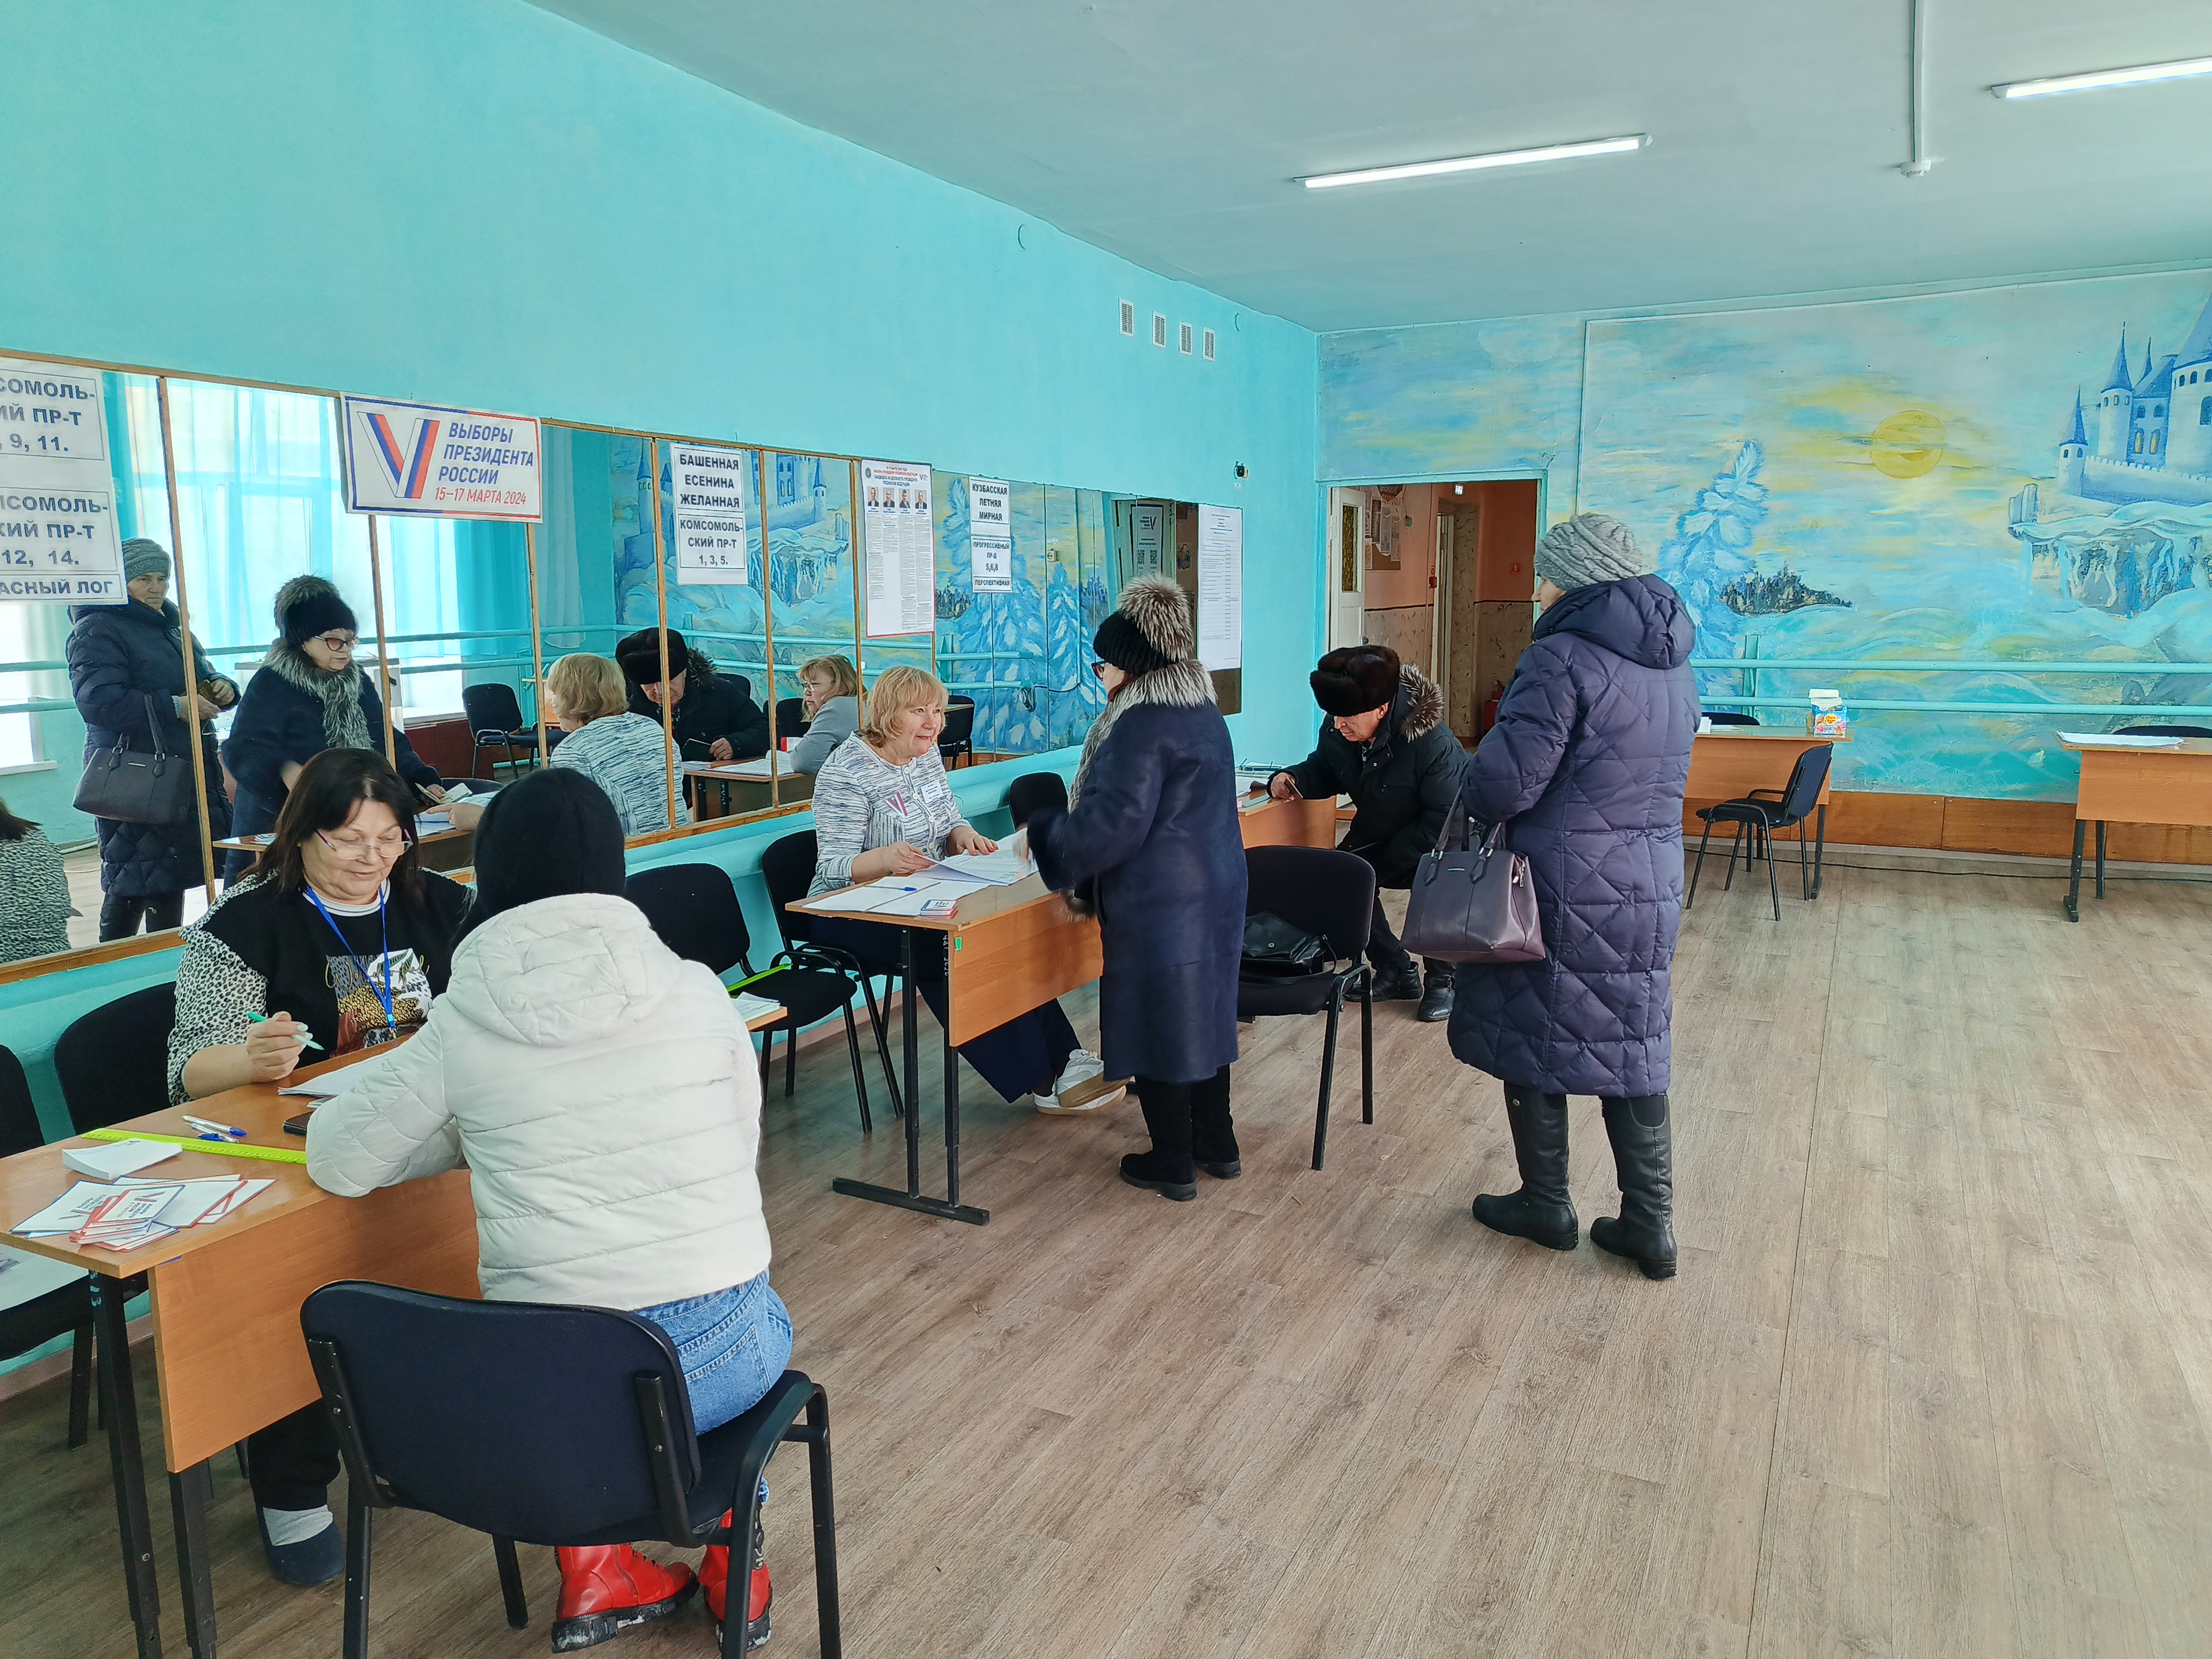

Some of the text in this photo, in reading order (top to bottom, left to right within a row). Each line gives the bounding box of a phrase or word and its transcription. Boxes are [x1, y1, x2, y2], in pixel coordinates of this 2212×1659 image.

[33, 408, 82, 426] ПР-Т
[448, 422, 513, 444] ВЫБОРЫ
[9, 434, 68, 452] 9, 11.
[443, 444, 533, 467] ПРЕЗИДЕНТА
[680, 454, 739, 470] БАШЕННАЯ
[438, 466, 499, 485] РОССИИ
[685, 474, 734, 488] ЕСЕНИНА
[972, 484, 1007, 495] КУЗБАССКАЯ
[467, 489, 502, 504] МАРТА
[504, 491, 526, 506] 2024
[680, 494, 739, 508] ЖЕЛАННАЯ
[979, 498, 1002, 508] ЛЕТНЯЯ
[979, 511, 1002, 521] МИРНАЯ
[47, 523, 95, 539] ПР-Т
[680, 519, 743, 532] КОМСОМОЛЬ-
[688, 536, 737, 549] СКИЙ ПР-Т
[973, 541, 1010, 550] ПРОГРЕССИВНЫЙ
[2, 550, 79, 567] 12, 14.
[698, 554, 728, 567] 1, 3, 5.
[986, 563, 998, 573] 5,6,8
[77, 581, 113, 594] ЛОГ
